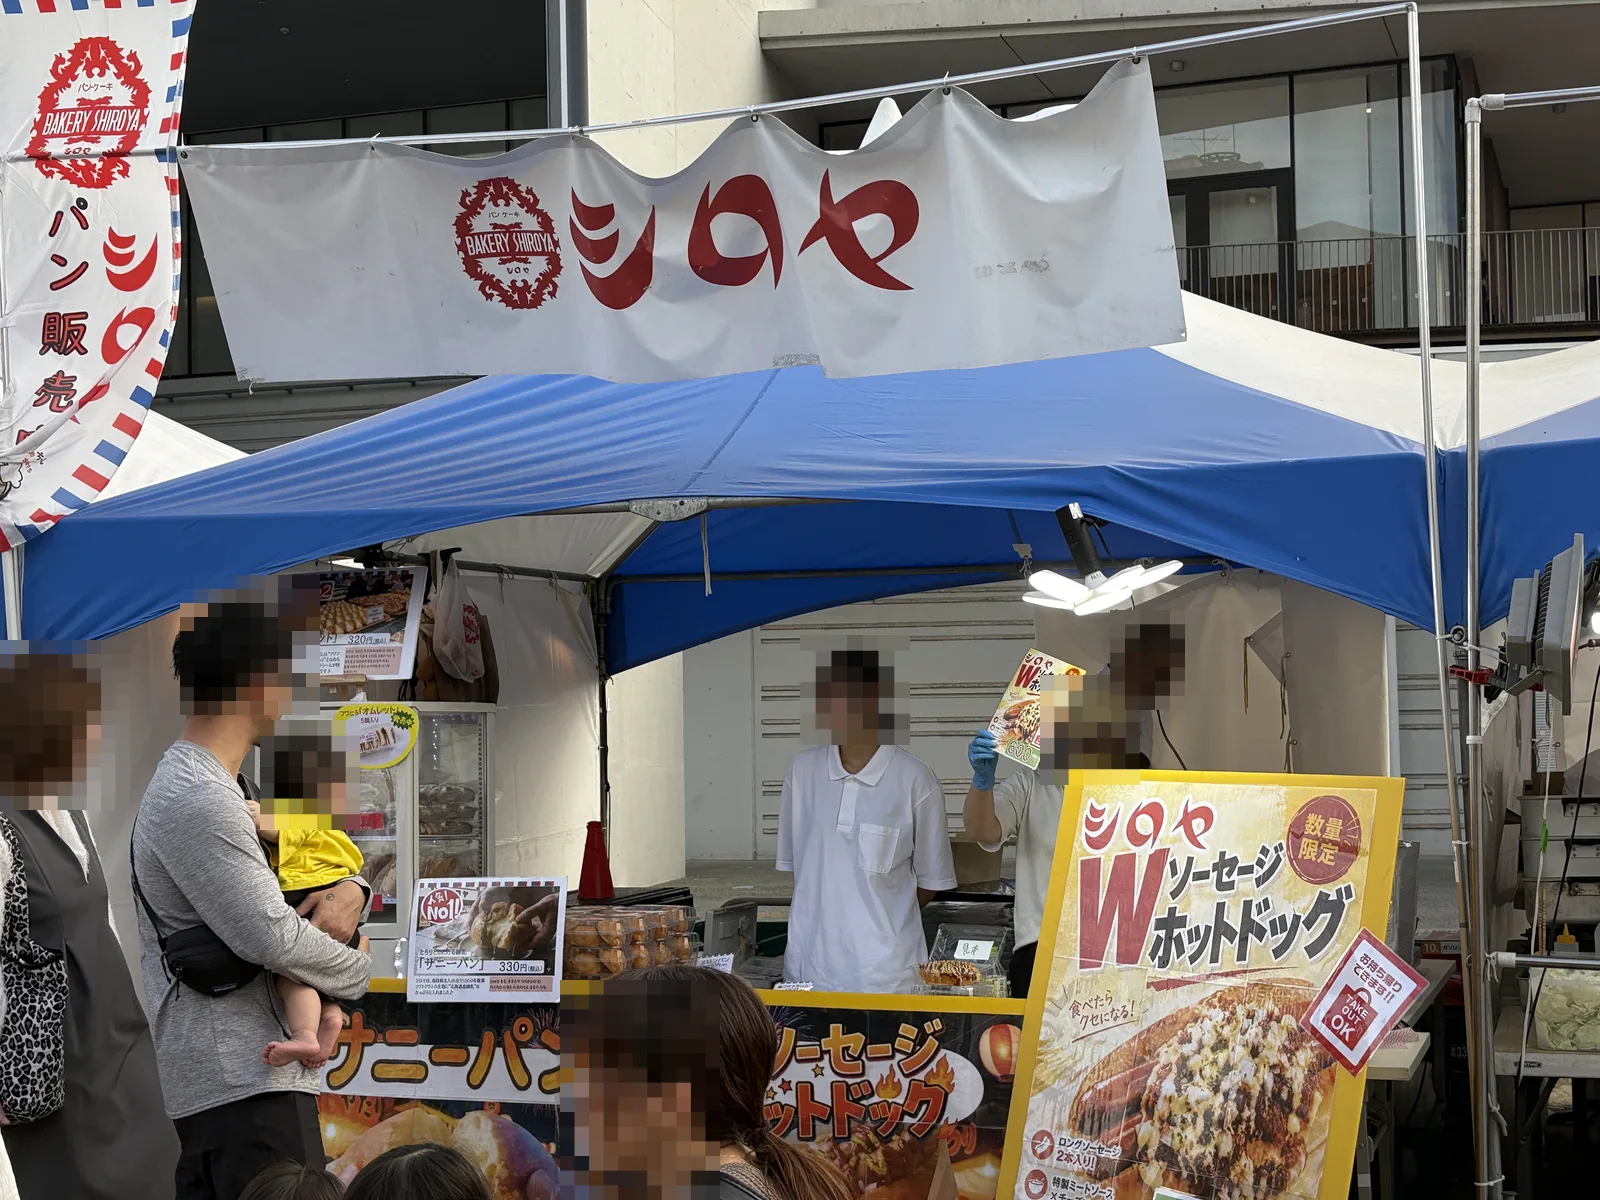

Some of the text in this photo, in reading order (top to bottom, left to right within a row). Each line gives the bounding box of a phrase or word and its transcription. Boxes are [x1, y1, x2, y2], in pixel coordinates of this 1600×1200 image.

[42, 108, 140, 135] BAKERY SHIROYA
[465, 232, 556, 256] BAKERY SHIROYA
[17, 197, 88, 446] パン販売
[1015, 664, 1041, 688] W
[1303, 812, 1344, 841] 数量
[1298, 837, 1338, 866] 限定
[1169, 842, 1284, 900] ソーセージ
[1079, 847, 1170, 969] W
[1149, 884, 1354, 969] ホットドッグ
[1359, 953, 1403, 993] お持ち帰り
[1069, 989, 1113, 1018] 食べたら
[1080, 1000, 1135, 1030] クセになる!
[1341, 1006, 1361, 1025] OUT
[1345, 994, 1369, 1019] TAKE
[1331, 1015, 1356, 1041] OK
[1055, 1150, 1096, 1169] 2本入り!
[1058, 1137, 1121, 1157] ロングソーセージ
[1052, 1176, 1114, 1199] 特製ミートソース
